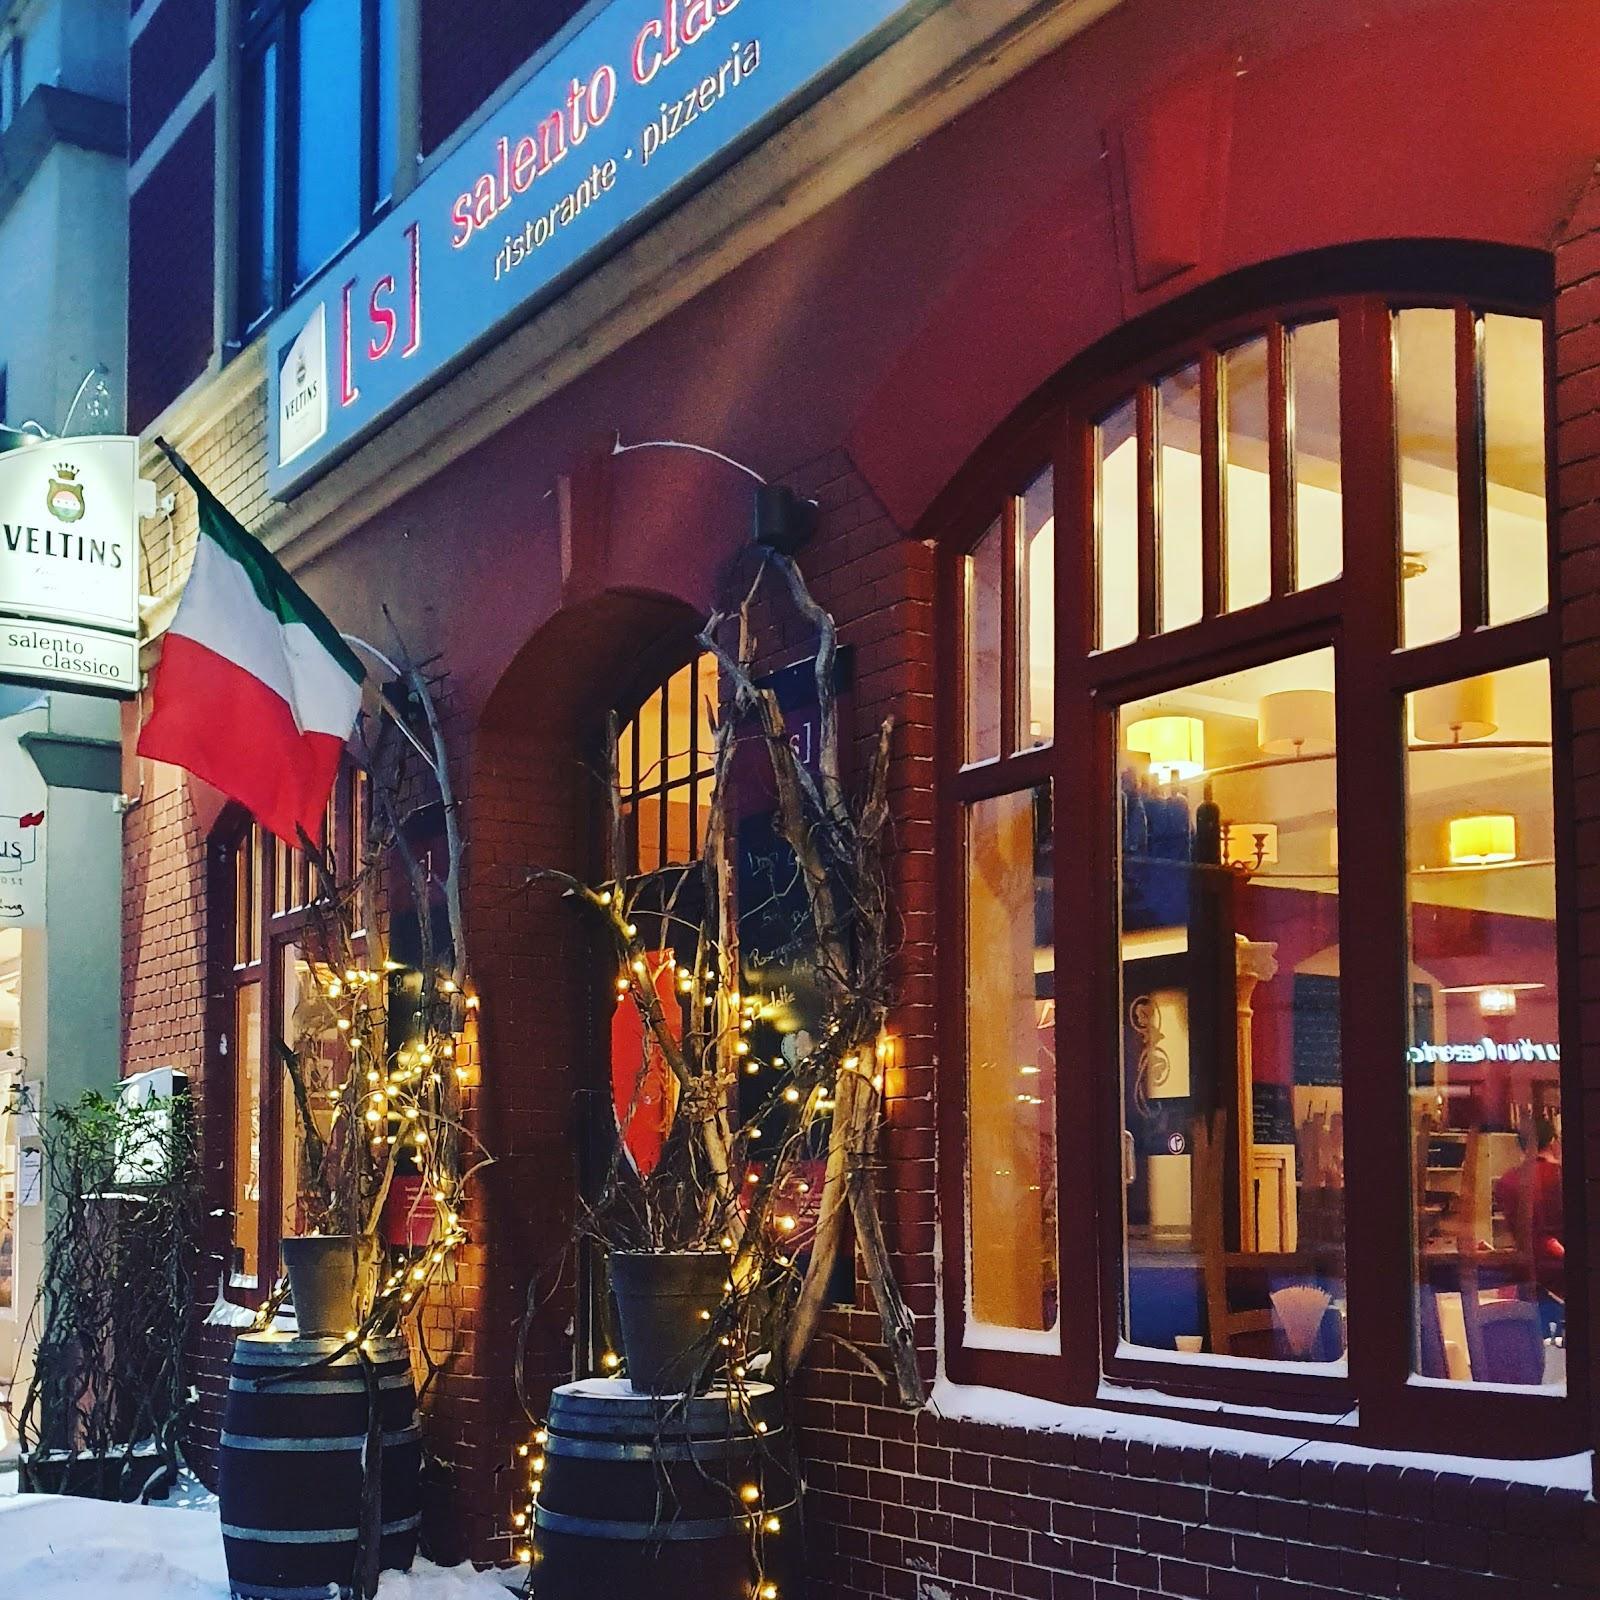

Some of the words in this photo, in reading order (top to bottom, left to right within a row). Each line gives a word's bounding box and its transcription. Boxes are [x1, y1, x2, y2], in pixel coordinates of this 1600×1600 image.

[450, 65, 618, 249] salento
[493, 156, 617, 282] ristorante
[640, 38, 761, 165] pizzeria
[285, 380, 318, 421] VELTINS
[3, 524, 122, 569] VELTINS
[8, 631, 84, 655] salento
[42, 651, 120, 678] classico
